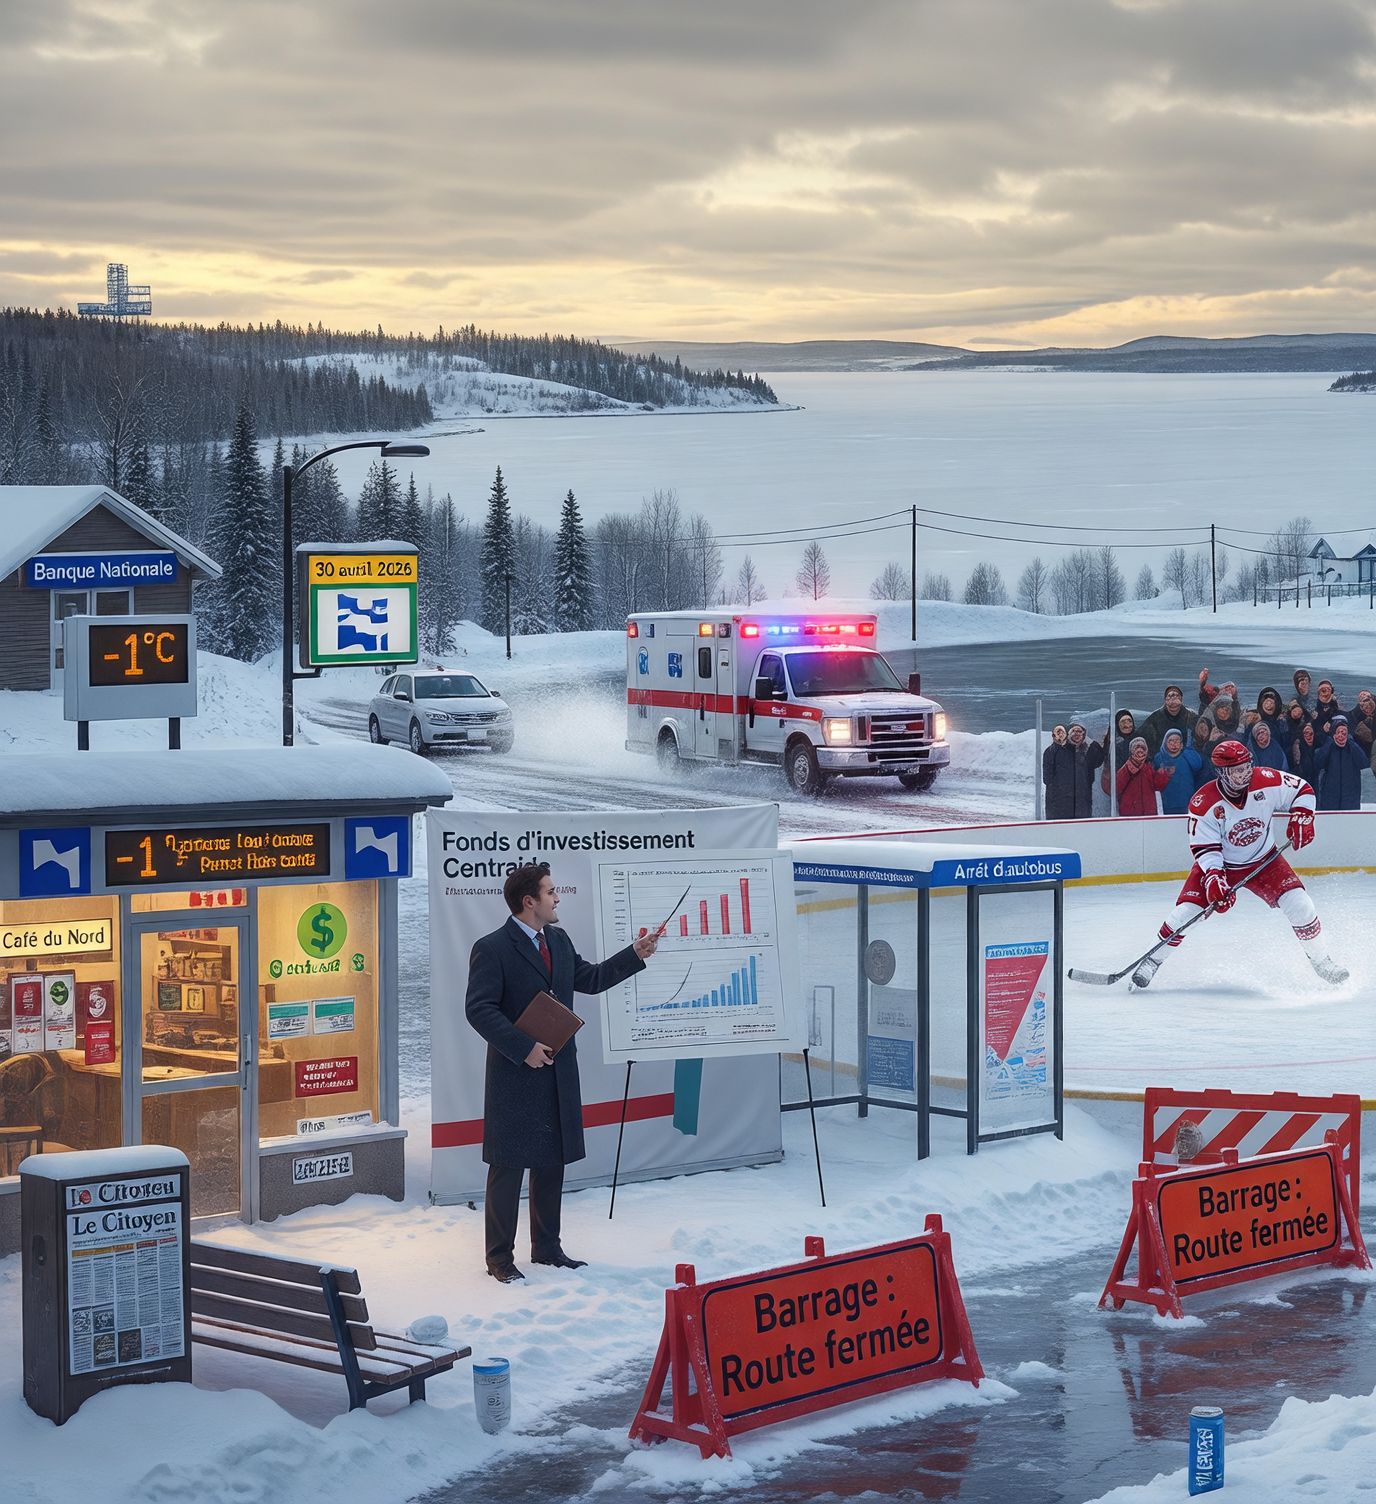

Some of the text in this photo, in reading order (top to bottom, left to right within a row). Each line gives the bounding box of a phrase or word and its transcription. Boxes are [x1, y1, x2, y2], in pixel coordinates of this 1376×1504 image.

[34, 560, 173, 583] Banque Nationale
[315, 562, 335, 577] 30
[377, 562, 413, 577] 2026
[104, 632, 176, 676] -1°C
[443, 830, 695, 851] Fonds d'investissement
[3, 927, 105, 949] Café du Nord
[1199, 1179, 1291, 1217] Barrage
[72, 1211, 177, 1236] Le Citoyen
[1174, 1206, 1328, 1266] Route fermée
[754, 1278, 878, 1334] Barrage
[721, 1310, 930, 1396] Route fermée
